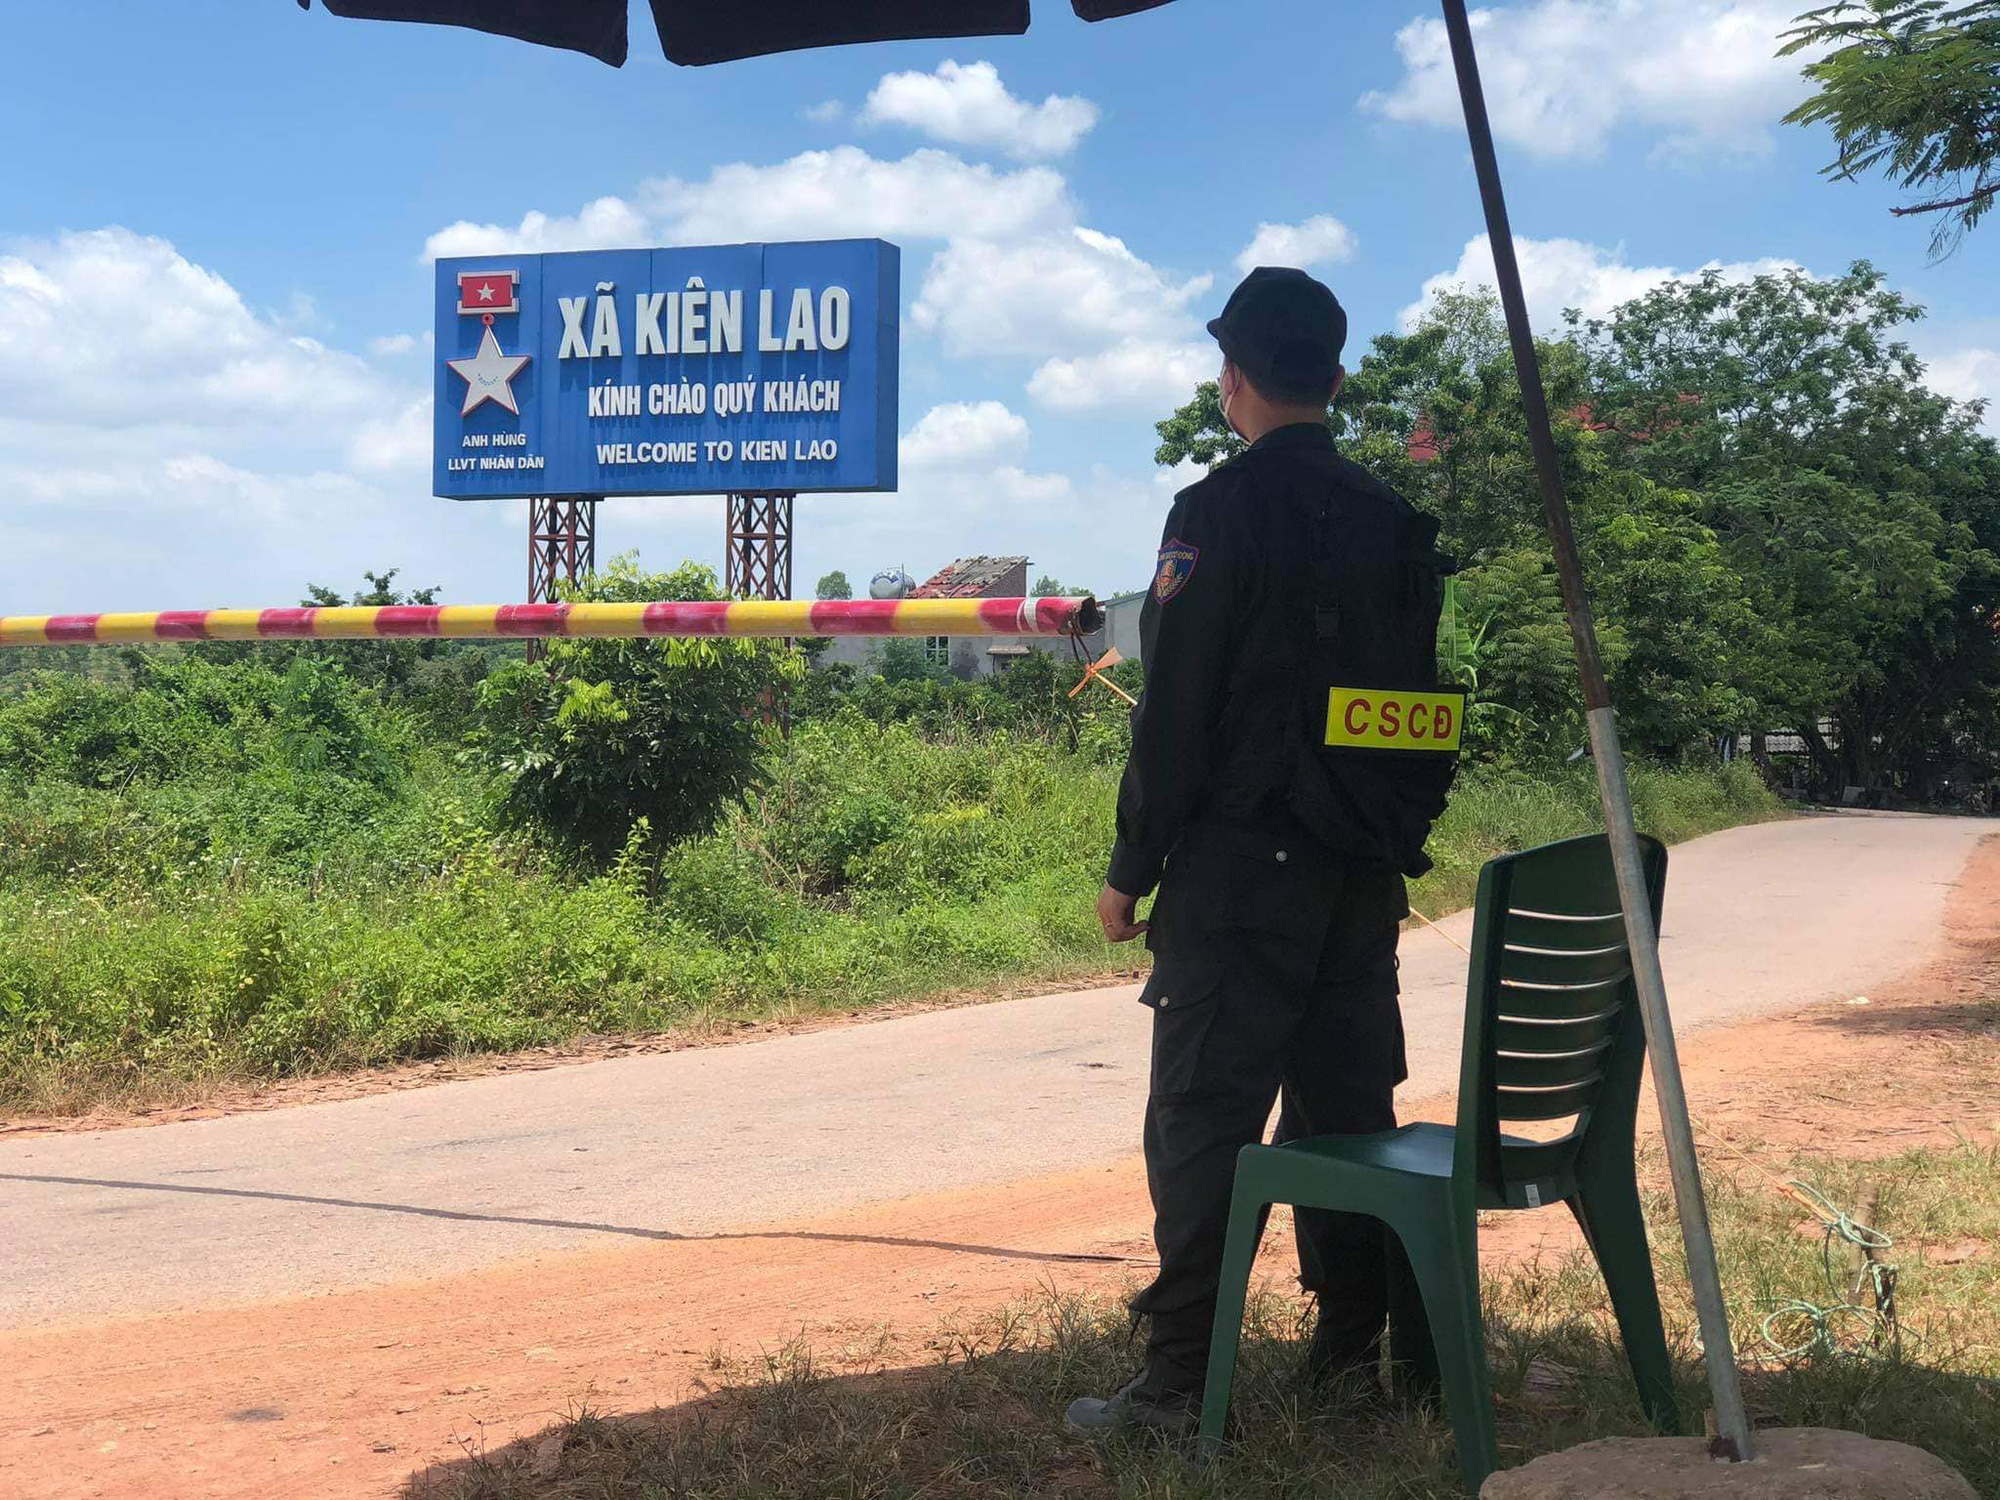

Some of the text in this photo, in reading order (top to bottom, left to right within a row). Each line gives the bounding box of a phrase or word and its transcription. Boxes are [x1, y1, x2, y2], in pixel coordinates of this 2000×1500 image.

[558, 277, 850, 359] XÃ KIÊN LAO
[588, 374, 840, 417] KÍNH CHÀO QUÝ KHÁCH
[462, 431, 526, 447] ANH HÙNG
[596, 439, 836, 464] WELCOME TO KIEN LAO
[448, 454, 544, 470] LLVT NHÂN DÂN
[1344, 699, 1453, 739] CSCĐ
